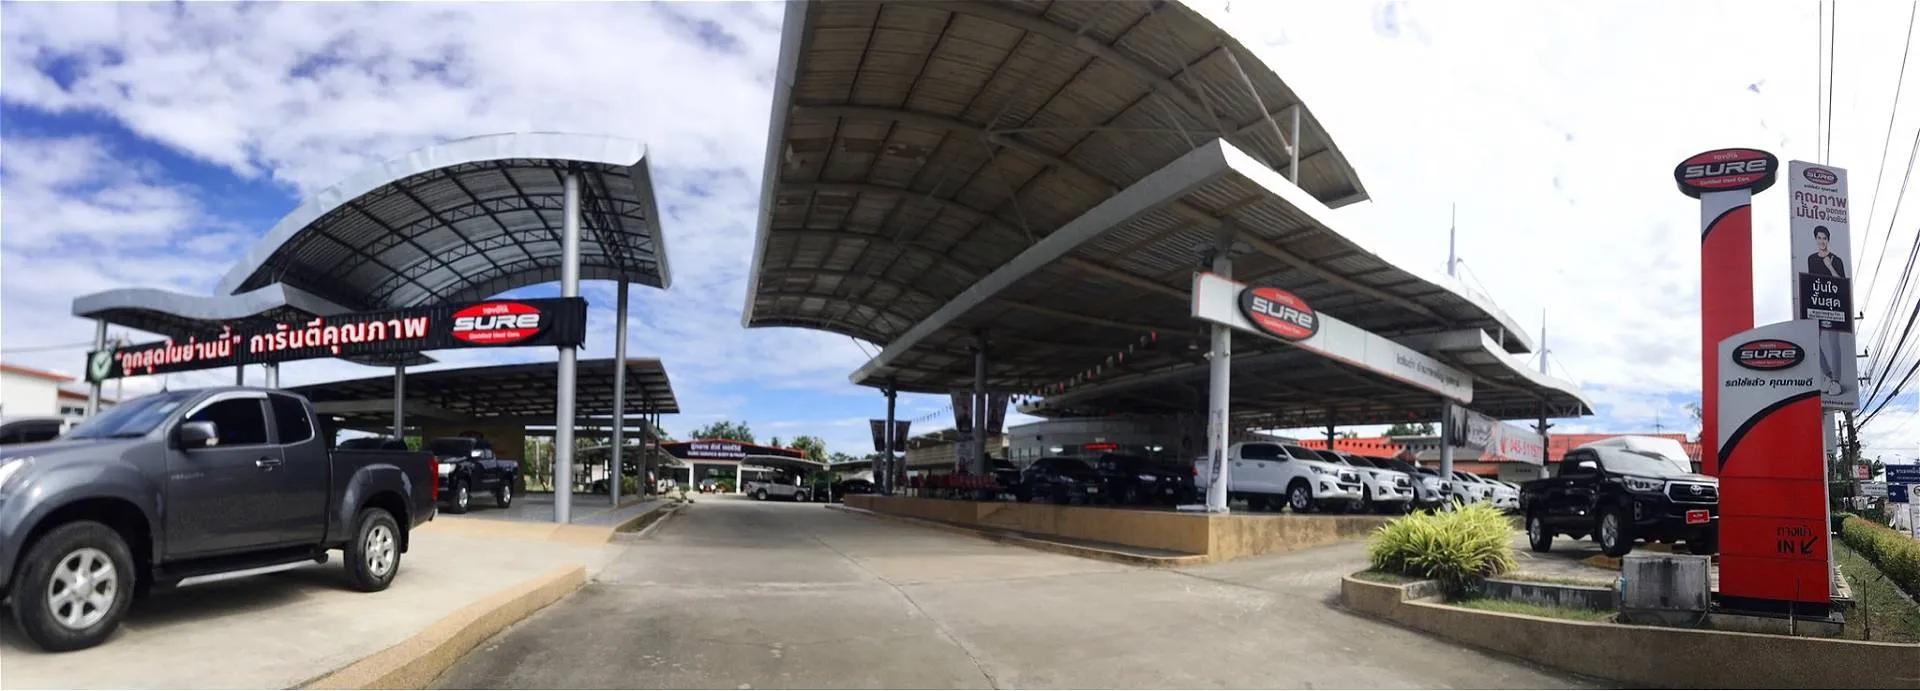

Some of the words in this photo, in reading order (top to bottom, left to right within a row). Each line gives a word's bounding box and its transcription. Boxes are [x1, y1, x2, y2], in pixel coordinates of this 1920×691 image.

[1713, 152, 1738, 160] TOYOTA
[1685, 159, 1767, 178] SURE
[1795, 190, 1847, 208] คุณภาพ
[1796, 203, 1826, 220] มั่นใจ
[1812, 278, 1839, 294] มั่นใจ
[1810, 291, 1841, 310] ขั้นสุด
[1251, 296, 1314, 329] SURE
[453, 313, 540, 331] SURE
[250, 316, 428, 355] การันตีคุณภาพ
[1741, 349, 1796, 359] SURE
[1725, 377, 1766, 388] รถใช้แล้ว
[1769, 377, 1814, 389] คุณภาพดี
[1777, 540, 1795, 553] IN
